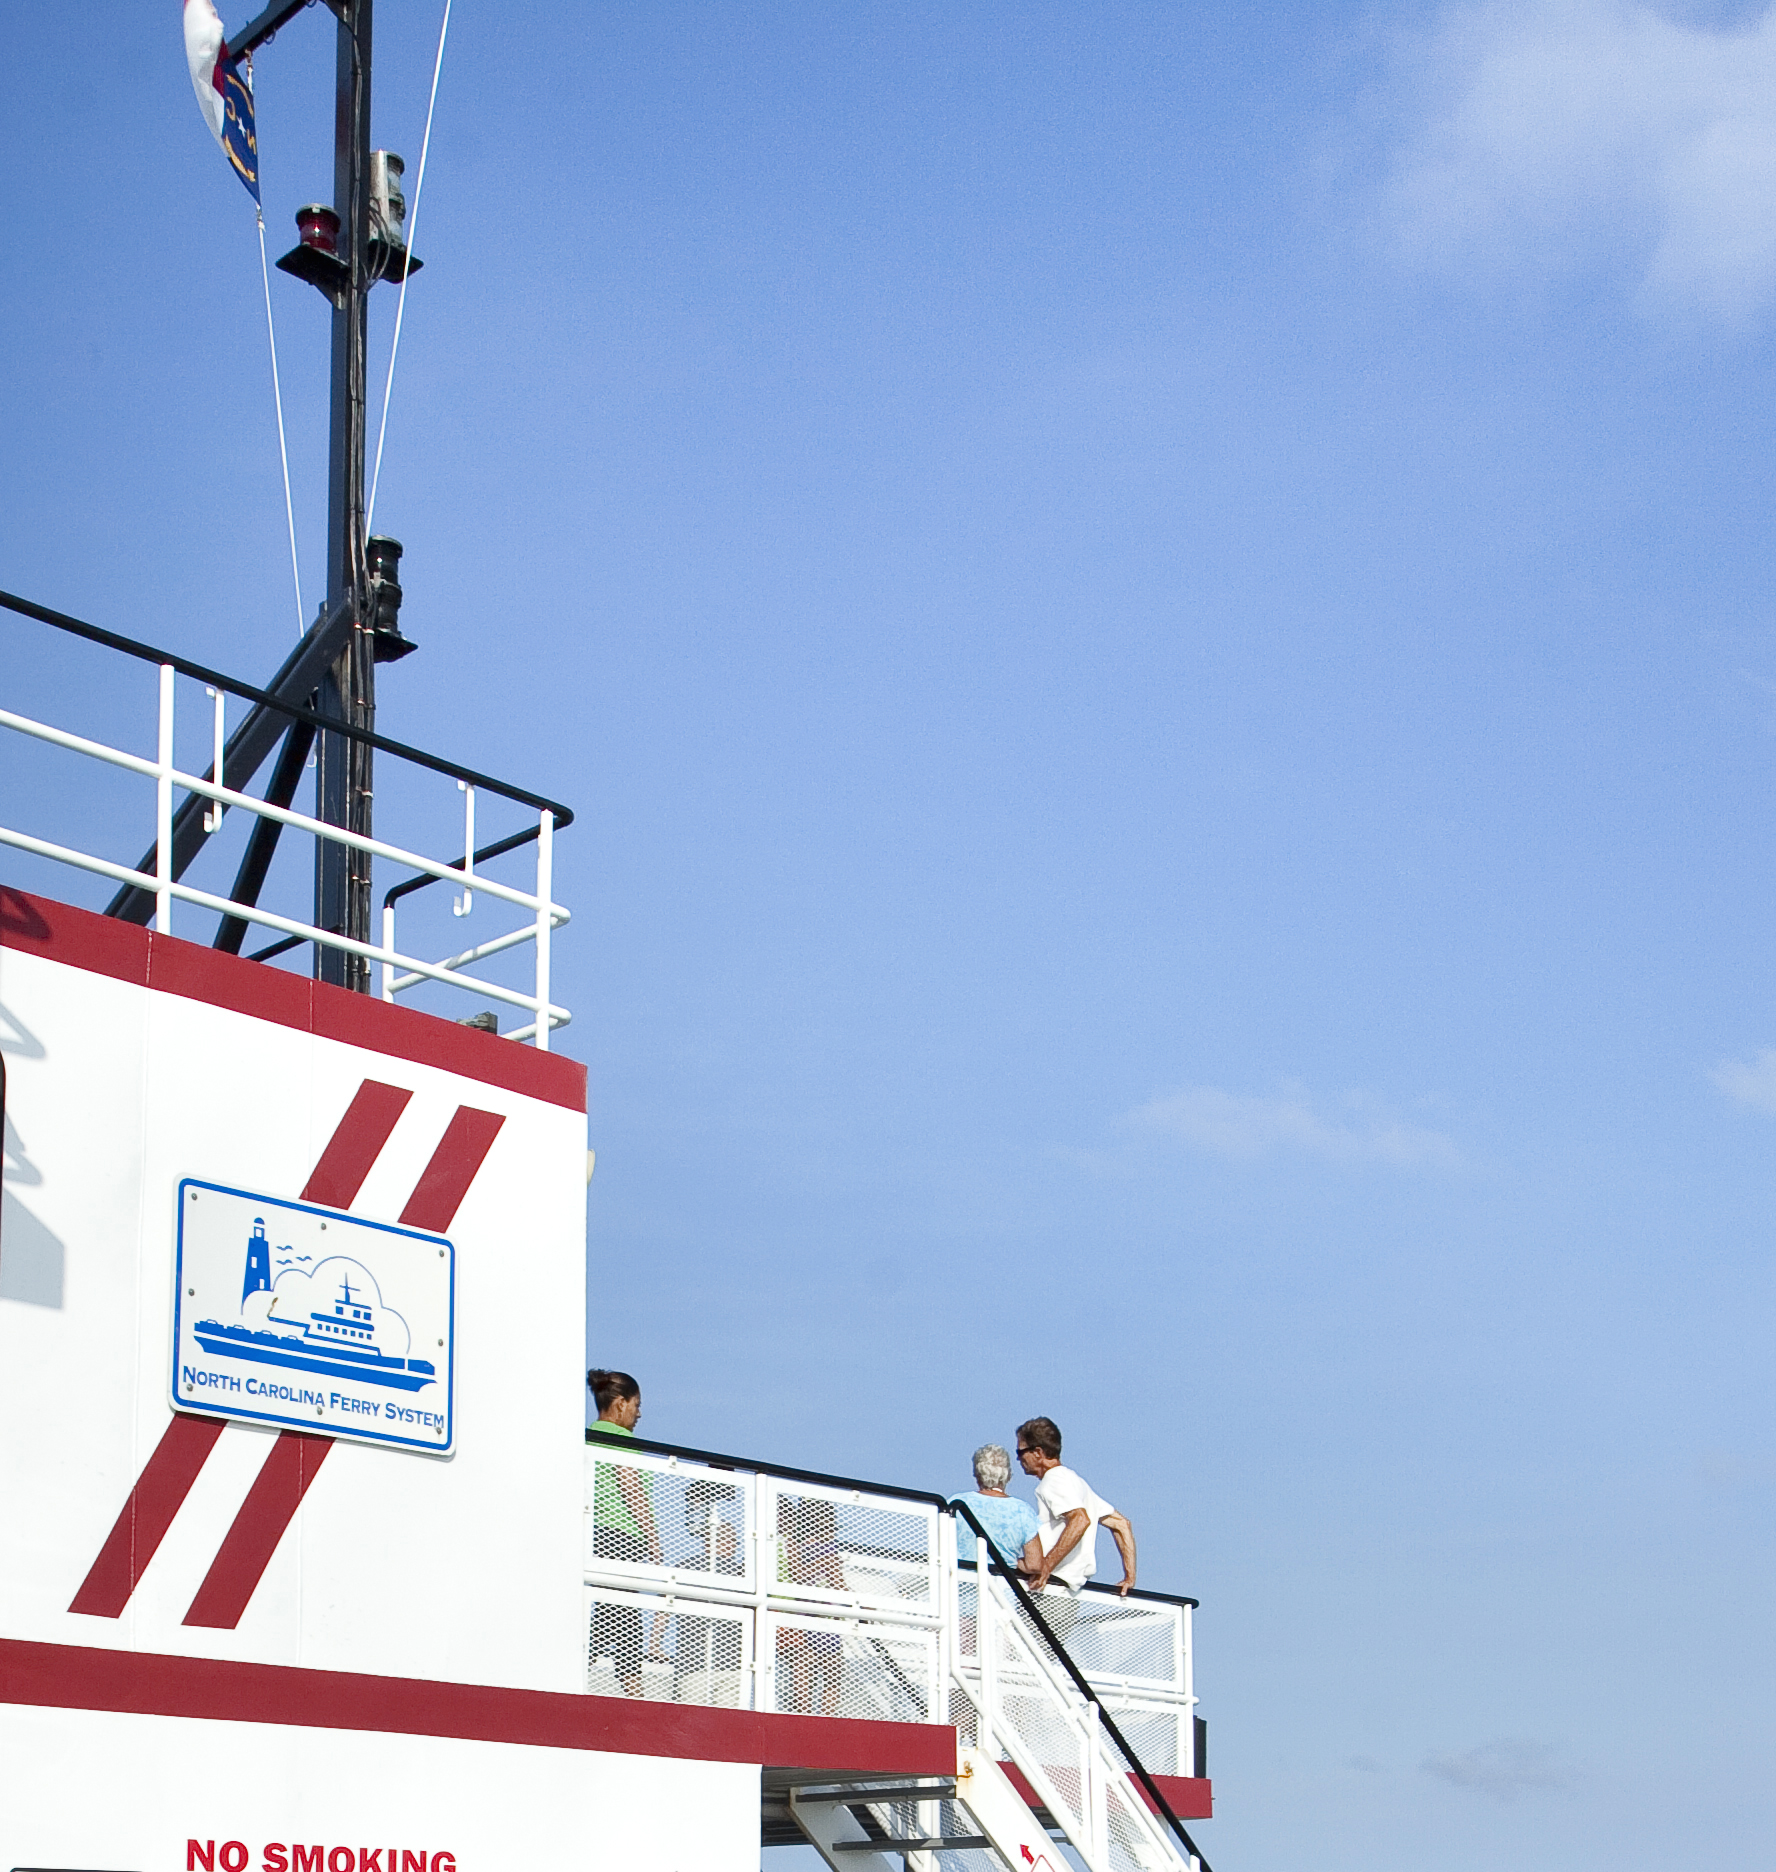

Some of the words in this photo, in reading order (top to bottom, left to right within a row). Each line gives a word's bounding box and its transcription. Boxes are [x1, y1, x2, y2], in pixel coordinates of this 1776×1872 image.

[182, 1365, 241, 1392] NORTH
[245, 1379, 325, 1407] CAROLINA
[330, 1393, 380, 1417] FERRY
[385, 1402, 445, 1428] SYSTEM
[186, 1839, 249, 1872] NO
